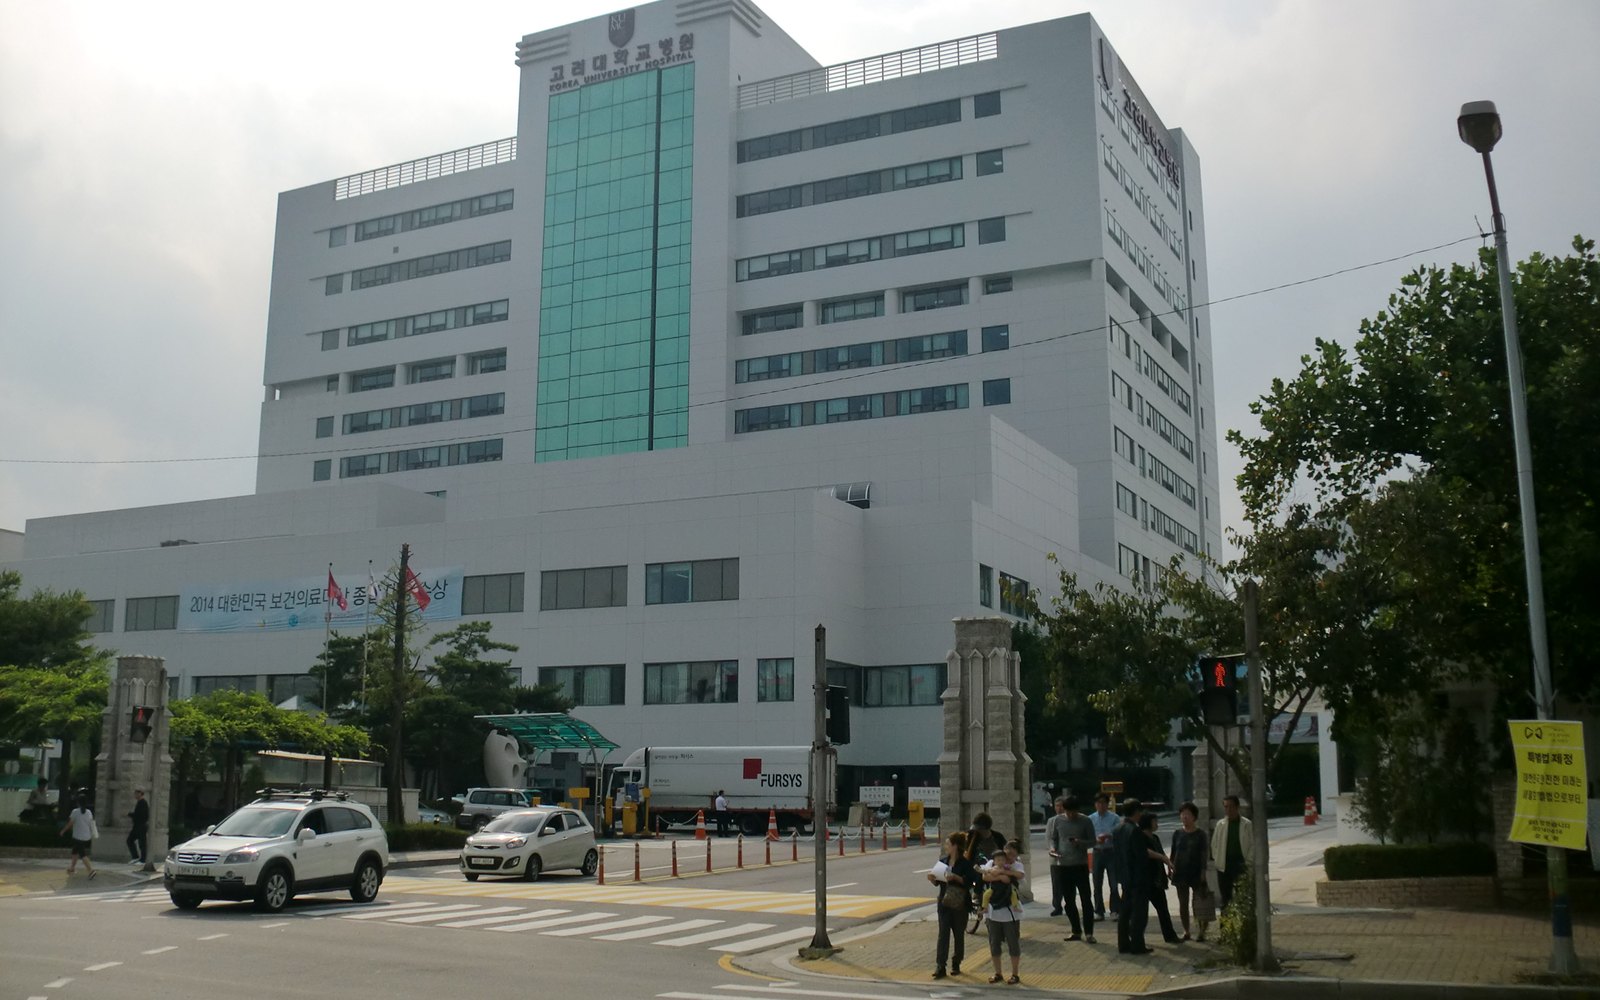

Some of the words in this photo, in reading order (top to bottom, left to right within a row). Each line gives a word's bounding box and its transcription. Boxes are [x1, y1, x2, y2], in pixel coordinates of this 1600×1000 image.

[549, 32, 694, 83] 고려대학교병원
[549, 78, 579, 92] KOREA
[584, 63, 640, 84] UNIVERSITY
[645, 51, 693, 69] HOSPITAL
[190, 596, 214, 613] 2014
[217, 591, 267, 613] 대한민국
[1527, 751, 1550, 764] 특별법
[1551, 753, 1574, 766] 제정
[760, 773, 802, 788] FURSYS
